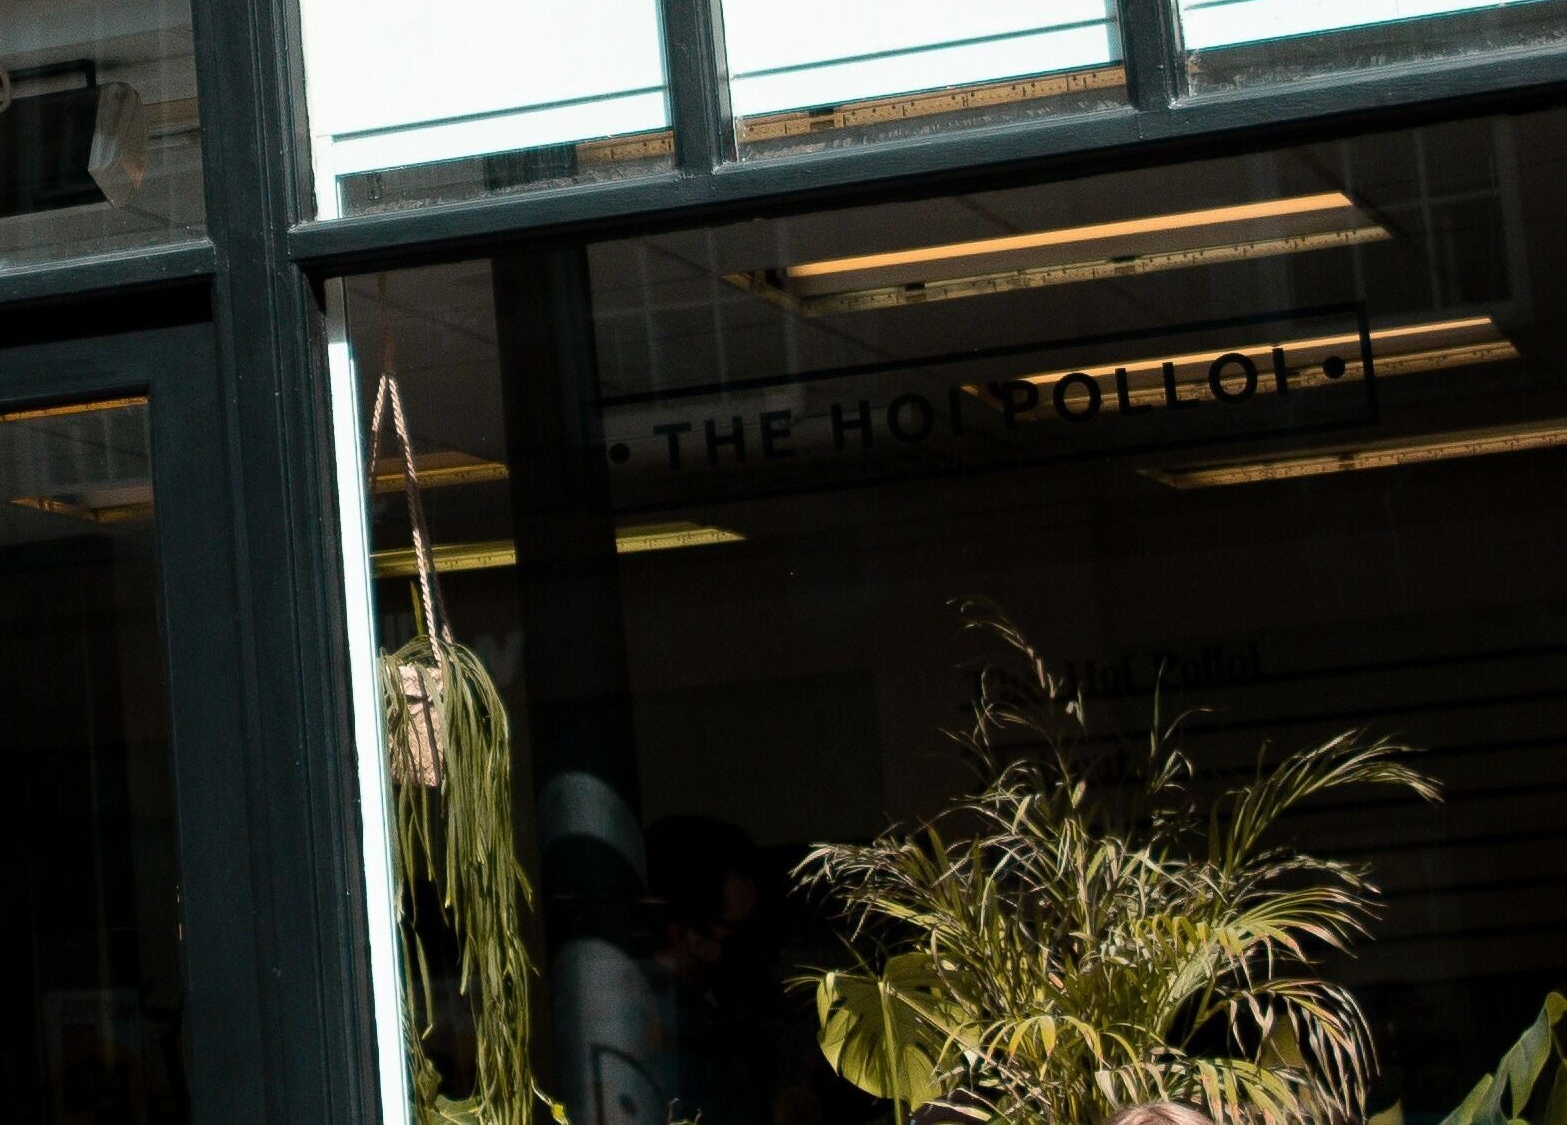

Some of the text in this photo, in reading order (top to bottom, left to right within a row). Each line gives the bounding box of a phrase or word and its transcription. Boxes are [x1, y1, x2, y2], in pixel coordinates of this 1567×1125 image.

[654, 349, 1289, 472] THE HOI POLLOI
[1064, 654, 1134, 697] Hoi
[1152, 639, 1261, 690] Polloi
